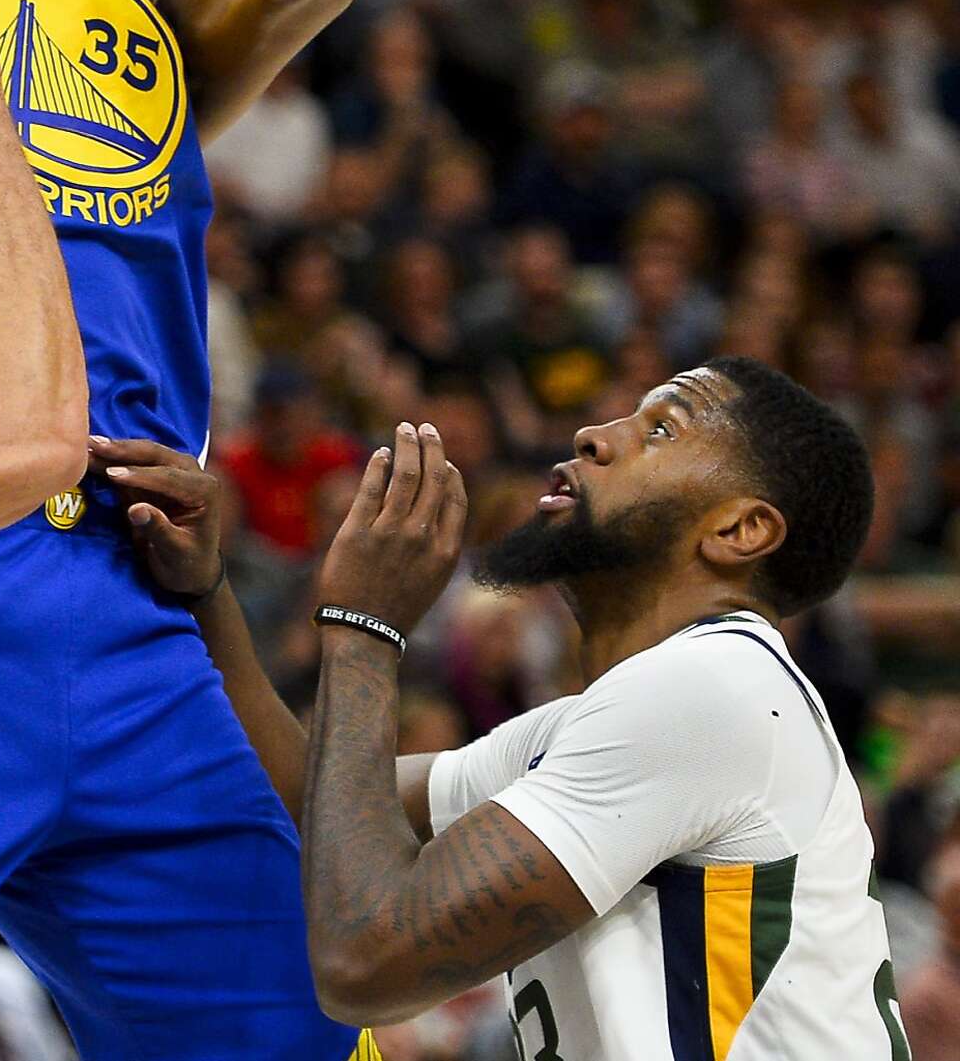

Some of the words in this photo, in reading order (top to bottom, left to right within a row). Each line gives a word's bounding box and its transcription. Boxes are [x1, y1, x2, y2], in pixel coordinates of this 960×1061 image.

[79, 18, 161, 92] 35
[33, 173, 172, 227] RRIORS
[54, 491, 83, 519] W
[321, 607, 345, 620] KIDS
[344, 611, 366, 625] GET
[365, 618, 401, 643] CANCER
